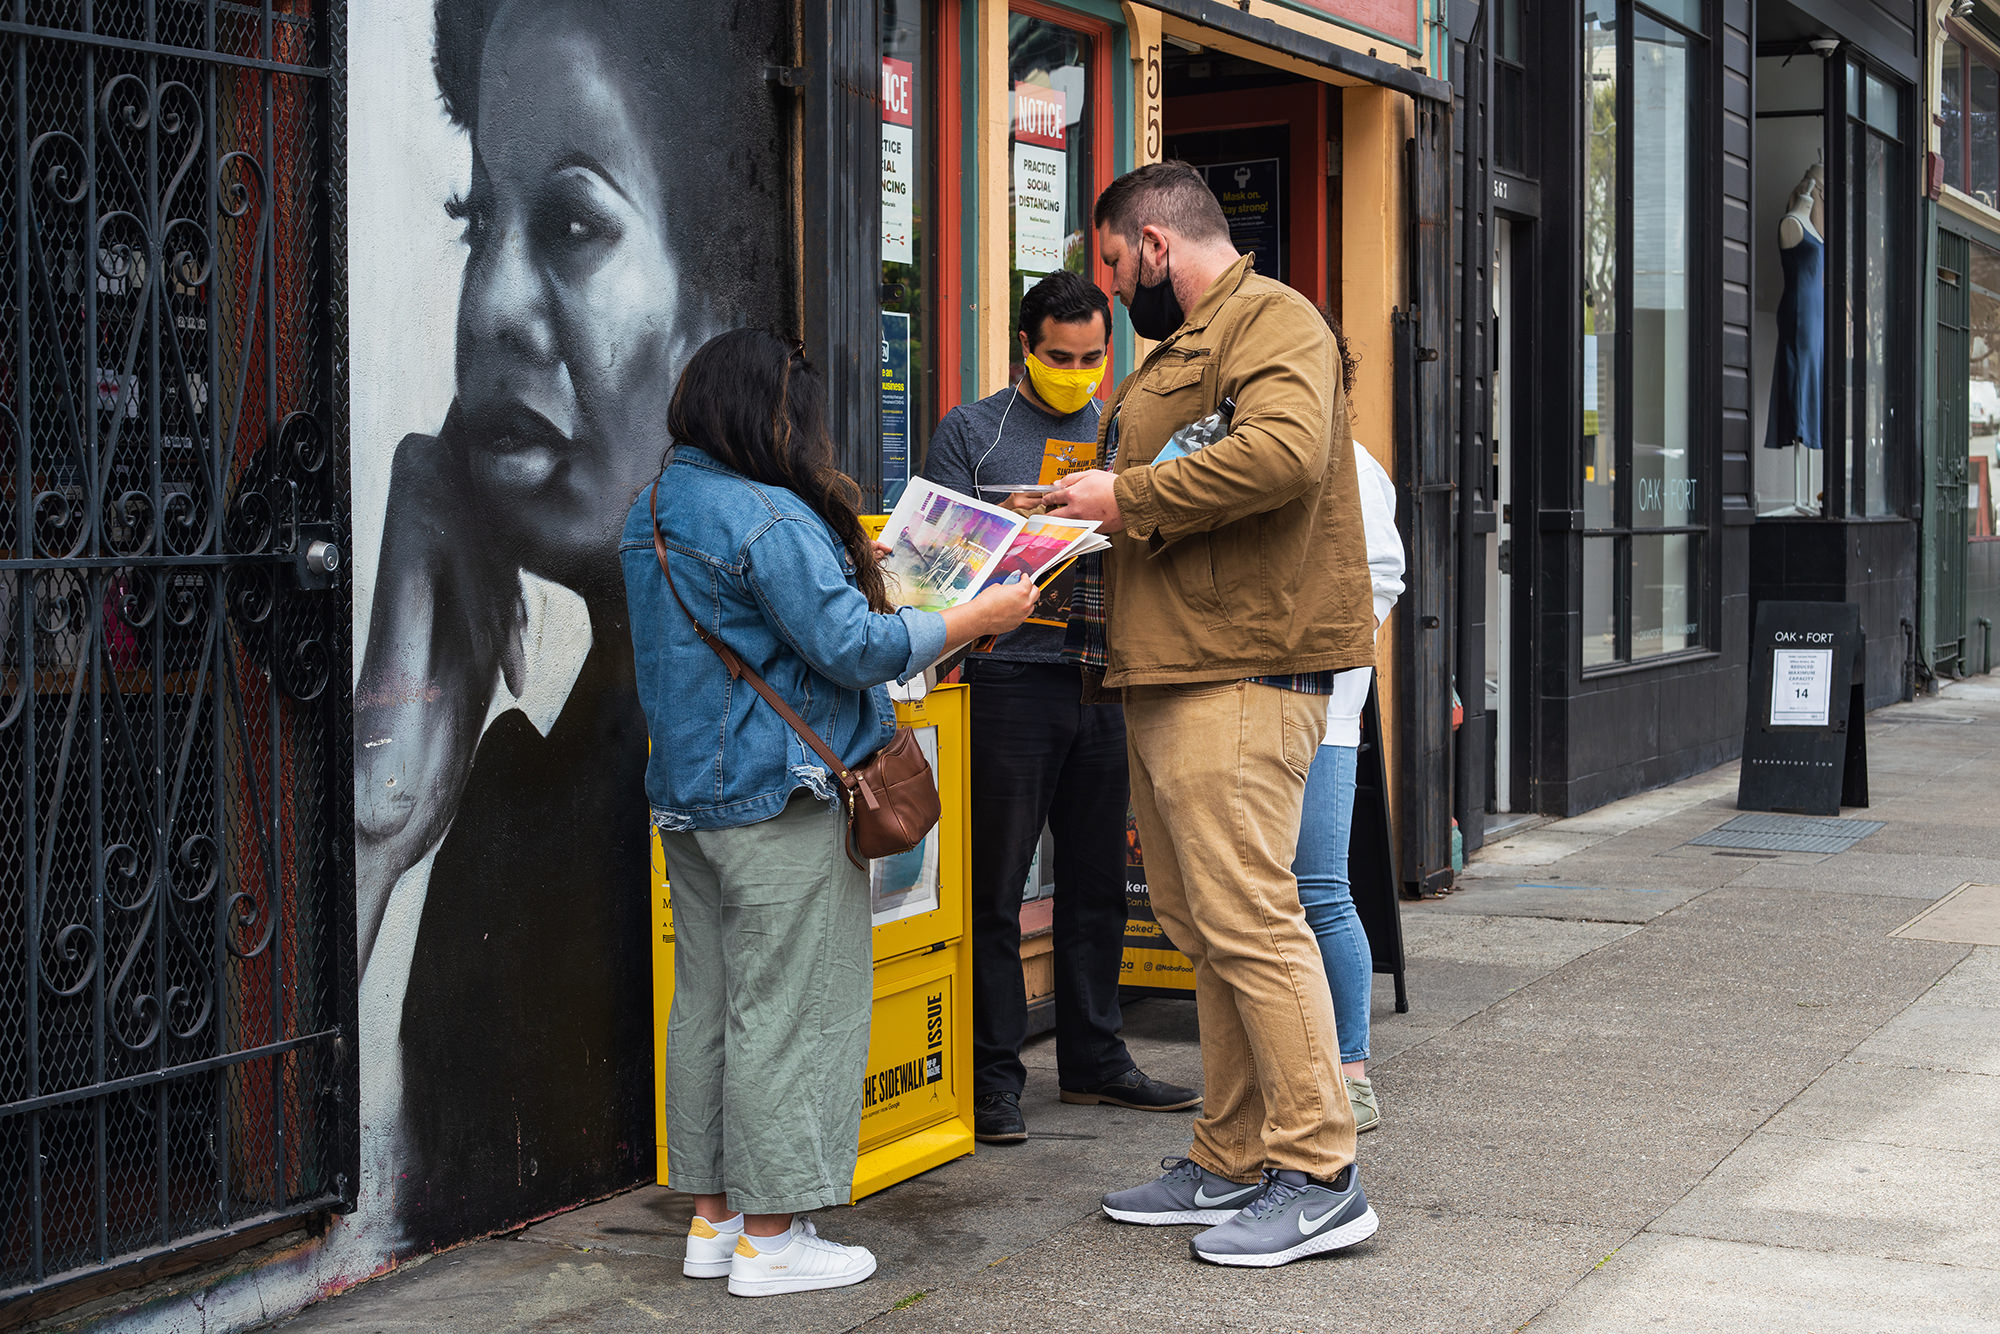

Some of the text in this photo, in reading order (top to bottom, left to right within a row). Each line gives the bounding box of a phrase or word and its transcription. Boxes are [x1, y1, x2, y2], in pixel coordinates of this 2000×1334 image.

[882, 71, 909, 114] ICE
[1018, 95, 1063, 139] NOTICE
[882, 139, 902, 155] TICE
[882, 159, 896, 173] IAL
[1023, 158, 1056, 176] PRACTICE
[1027, 178, 1051, 193] SOCIAL
[1018, 194, 1060, 213] DISTANCING
[1223, 191, 1246, 202] Mask
[1238, 201, 1269, 213] strong!
[1638, 477, 1662, 512] OAK
[1671, 477, 1698, 512] FORT
[1774, 631, 1797, 642] OAK
[1806, 632, 1834, 643] FORT
[1795, 688, 1809, 699] 14
[928, 991, 942, 1050] ISSUE
[878, 1056, 926, 1103] SIDEWALK
